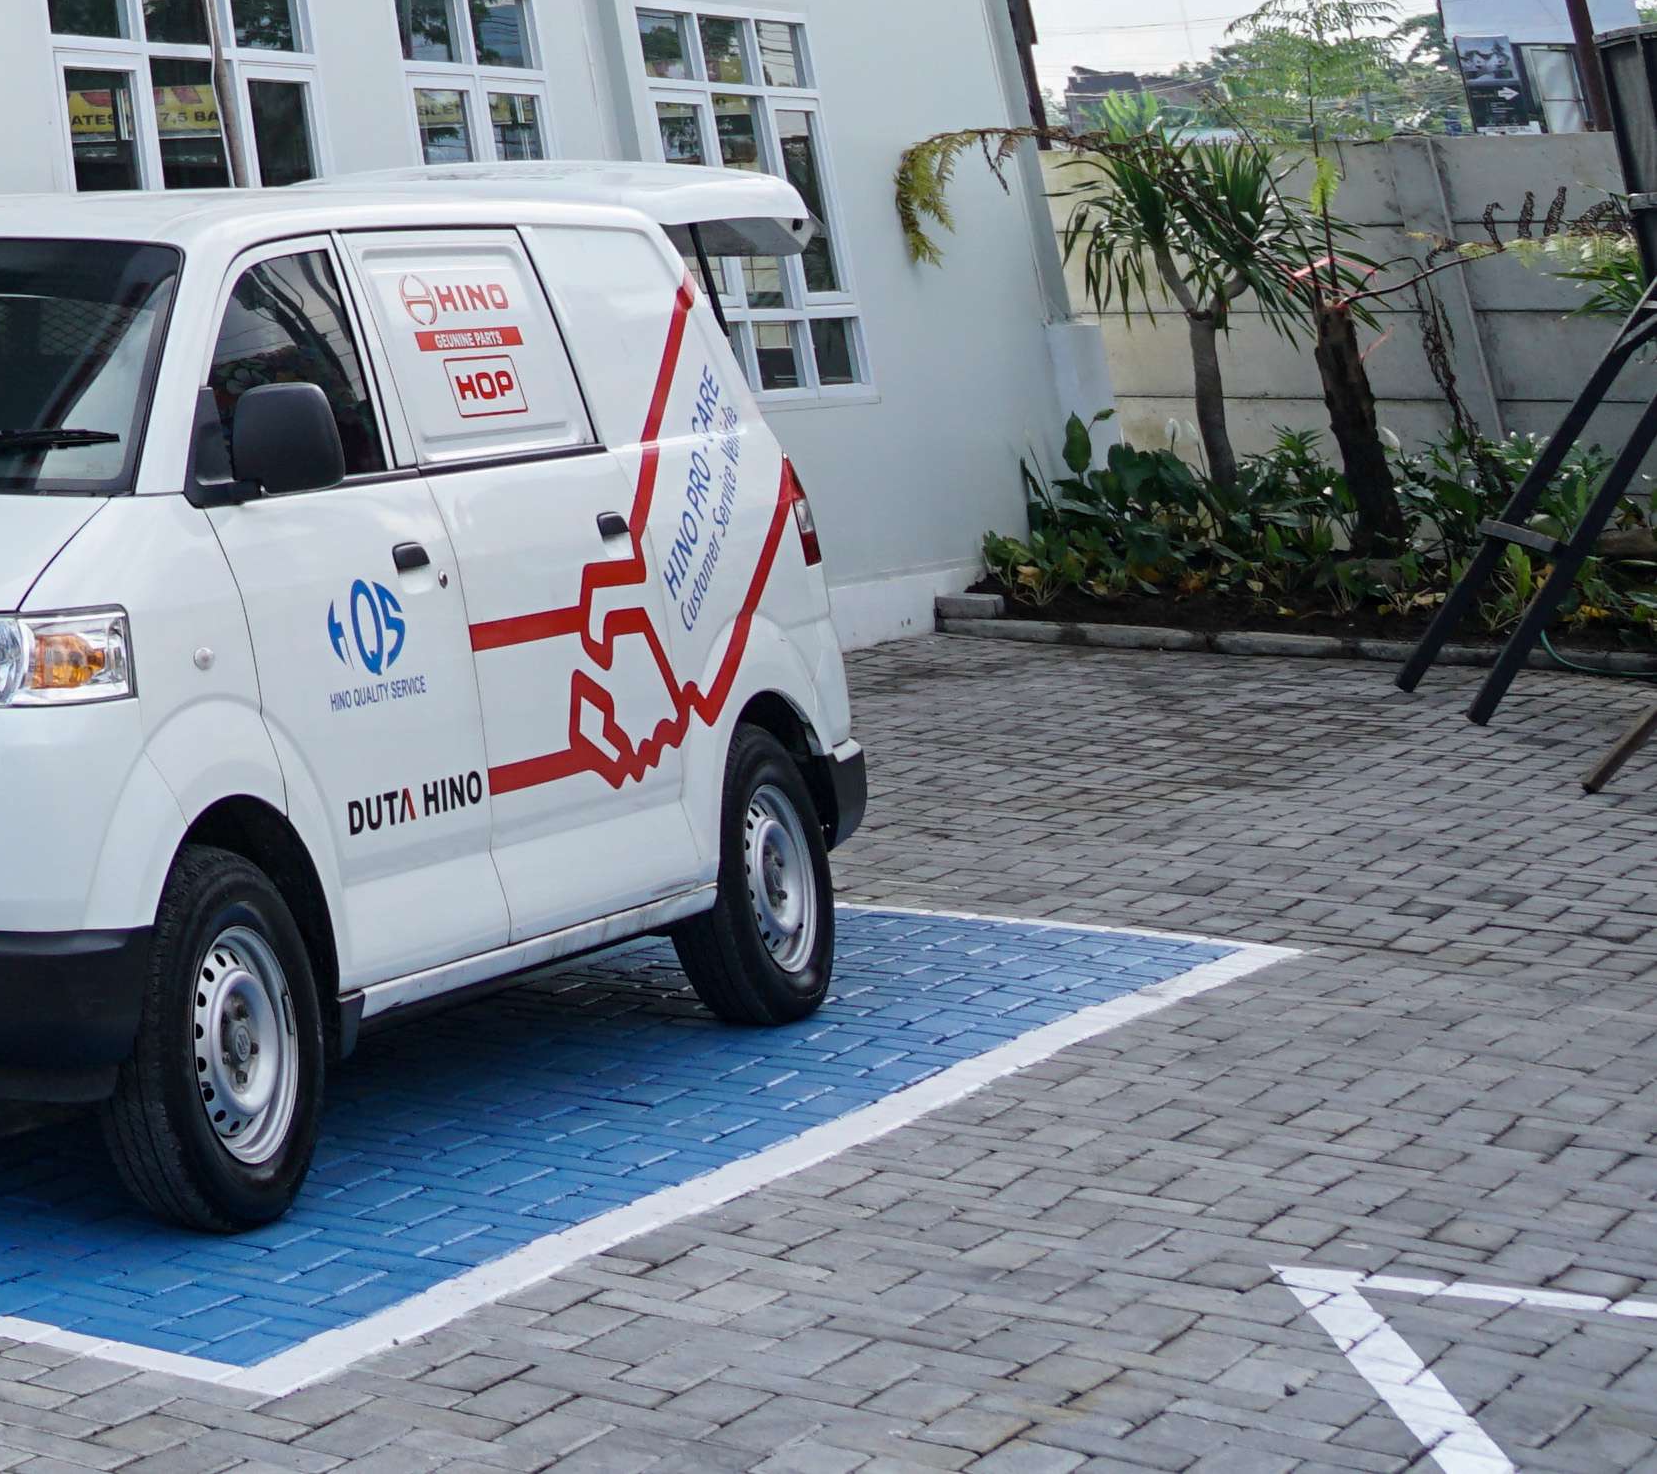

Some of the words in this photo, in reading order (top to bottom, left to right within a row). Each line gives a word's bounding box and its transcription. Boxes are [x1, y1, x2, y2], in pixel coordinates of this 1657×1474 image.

[434, 284, 509, 311] HINO
[434, 333, 475, 348] GEUNINE
[475, 331, 503, 346] PARTS
[455, 371, 514, 400] HOP
[691, 365, 720, 441] CARE
[687, 450, 712, 521] PRO
[663, 511, 698, 601] HINO
[680, 532, 722, 632] Customer
[712, 465, 738, 538] Service
[330, 689, 352, 712] HINO
[353, 681, 389, 708] QUALITY
[390, 675, 427, 701] SERVICE
[348, 788, 417, 836] DUTA
[423, 770, 483, 817] HINO
